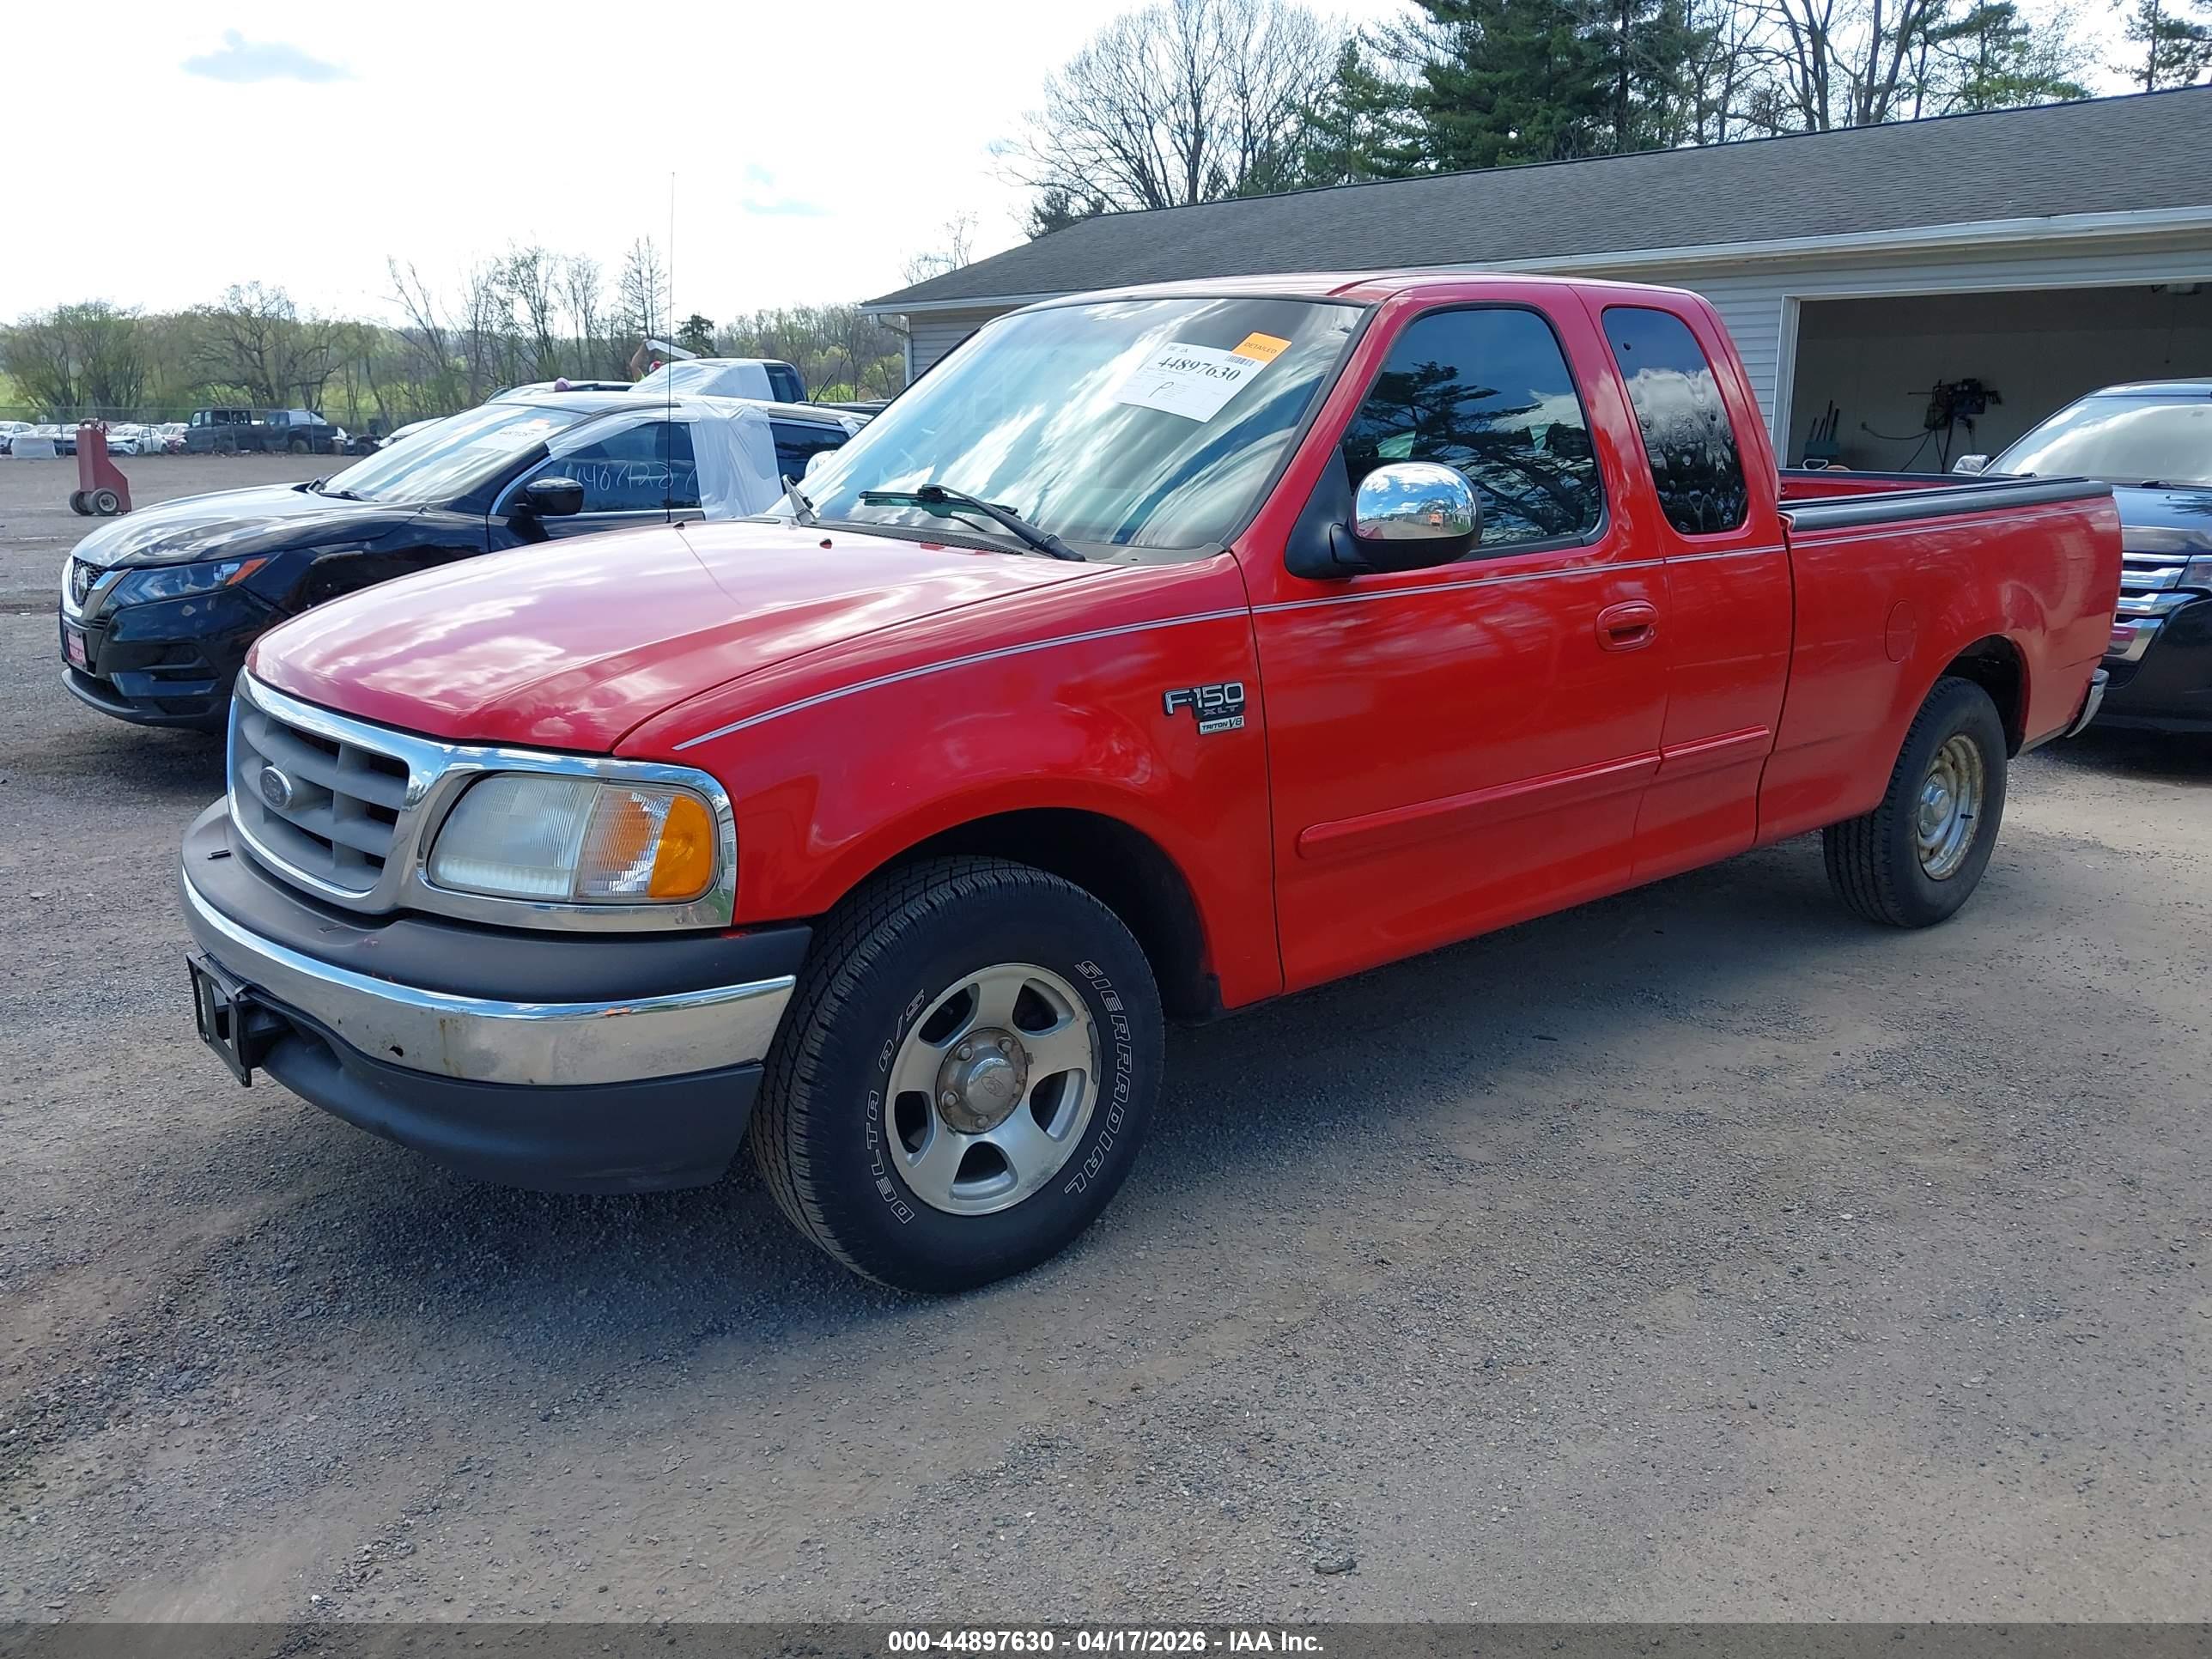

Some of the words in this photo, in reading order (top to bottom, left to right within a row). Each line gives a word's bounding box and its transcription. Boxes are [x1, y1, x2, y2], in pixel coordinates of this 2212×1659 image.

[1243, 342, 1278, 355] DETAILED
[1158, 356, 1242, 381] 44897630
[1164, 682, 1244, 714] F-150
[1202, 704, 1239, 716] XLT
[1201, 722, 1229, 732] TRITON
[1228, 717, 1243, 729] V8
[1064, 960, 1133, 1194] SIERRADIAL
[866, 1090, 915, 1224] DELTA
